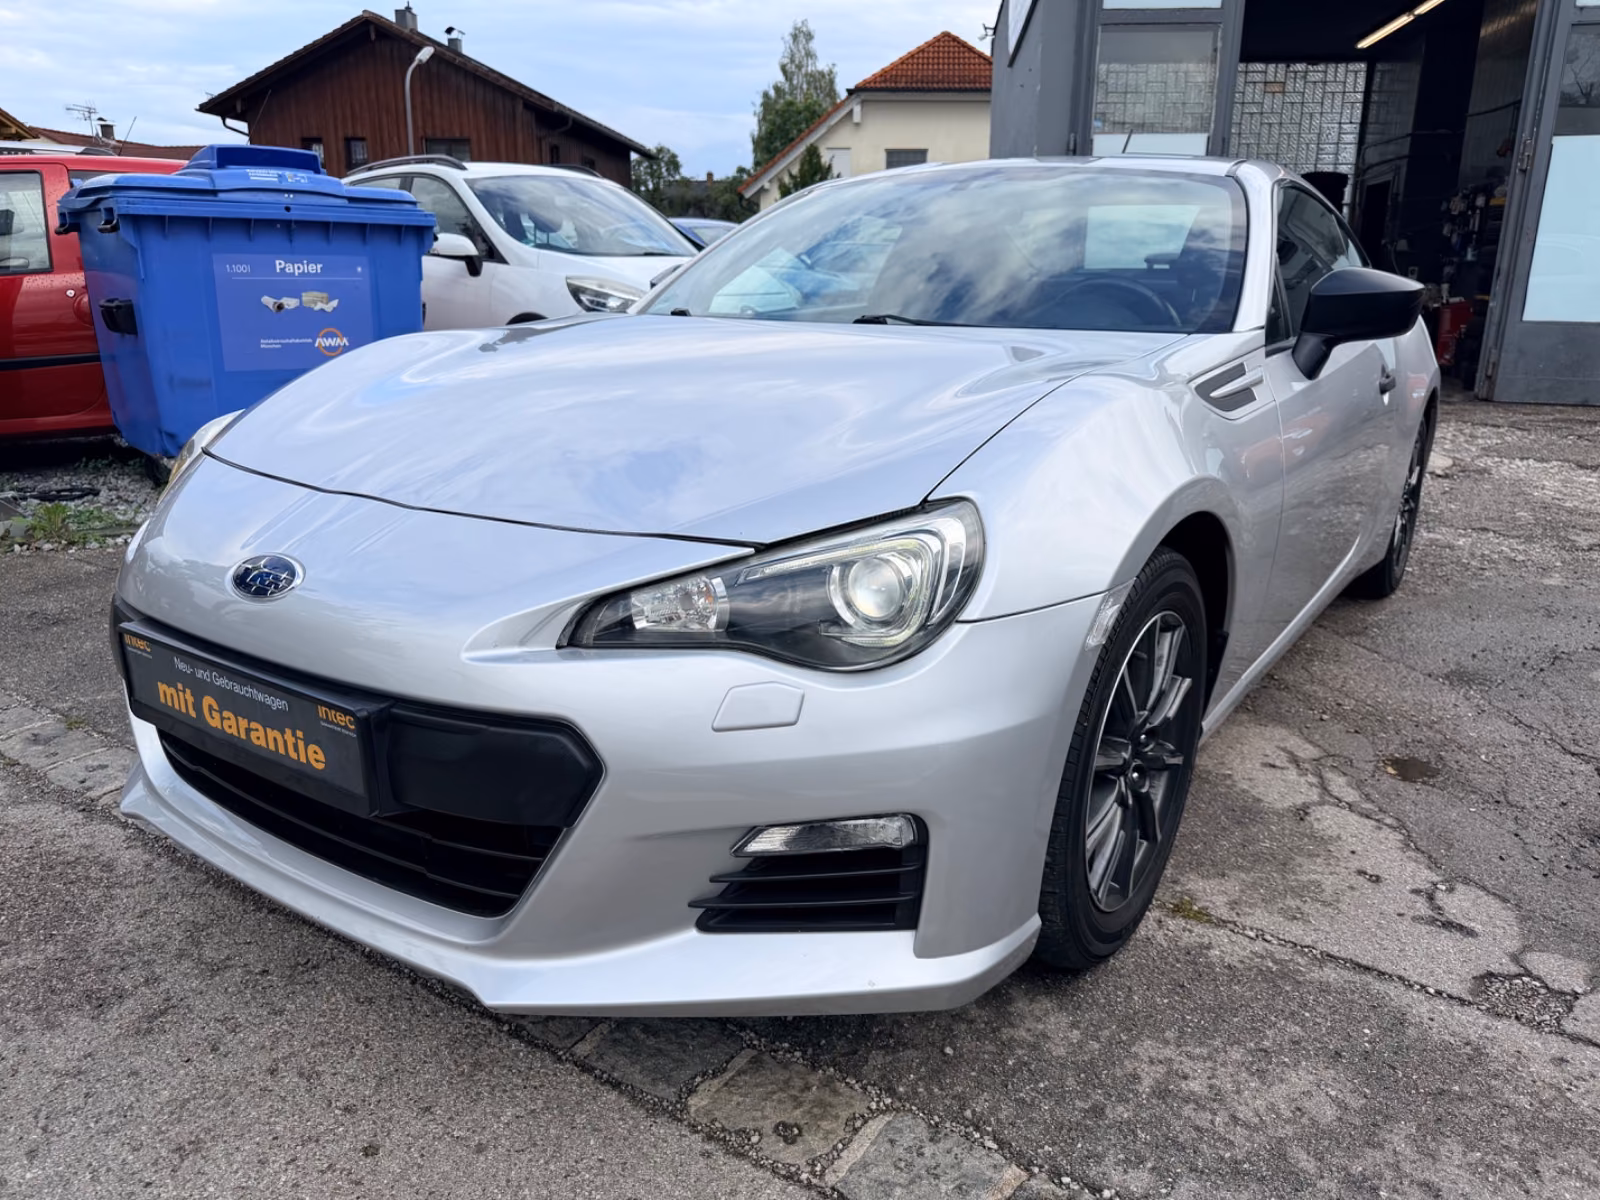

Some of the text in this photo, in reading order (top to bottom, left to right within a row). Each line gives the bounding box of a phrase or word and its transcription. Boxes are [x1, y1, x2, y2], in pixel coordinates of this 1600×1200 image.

[275, 259, 324, 276] Papier
[314, 336, 350, 348] AWM
[174, 656, 289, 712] Neu- und Gebrauchtwagen
[157, 681, 326, 770] mit Garantie
